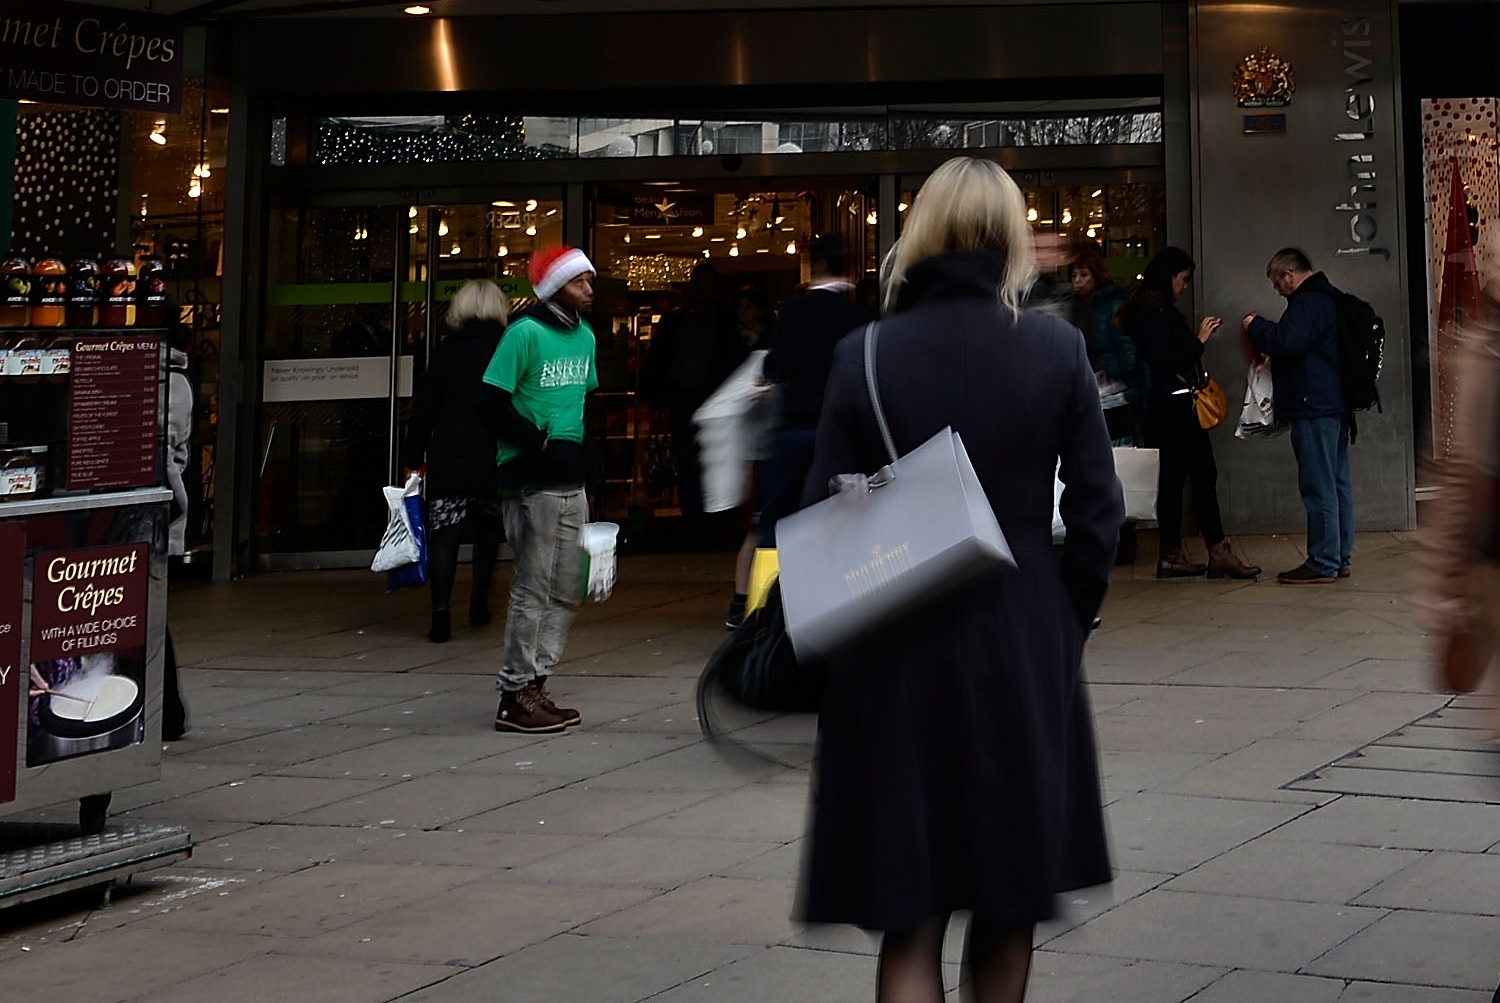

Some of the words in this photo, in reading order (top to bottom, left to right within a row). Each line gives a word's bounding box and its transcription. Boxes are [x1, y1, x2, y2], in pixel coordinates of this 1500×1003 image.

[75, 18, 175, 69] Crêpes
[9, 69, 66, 94] MADE
[72, 75, 99, 97] TO
[104, 78, 171, 104] ORDER
[1334, 154, 1391, 262] John
[75, 341, 109, 352] Gourmet
[136, 342, 158, 350] MENU
[47, 550, 138, 583] Gourmet
[57, 583, 125, 616] Crêpes
[41, 629, 66, 641] WITH
[66, 626, 75, 637] A
[76, 621, 100, 635] WIDE
[101, 615, 137, 632] CHOICE
[61, 640, 76, 652] OF
[77, 633, 118, 649] FILLINGS
